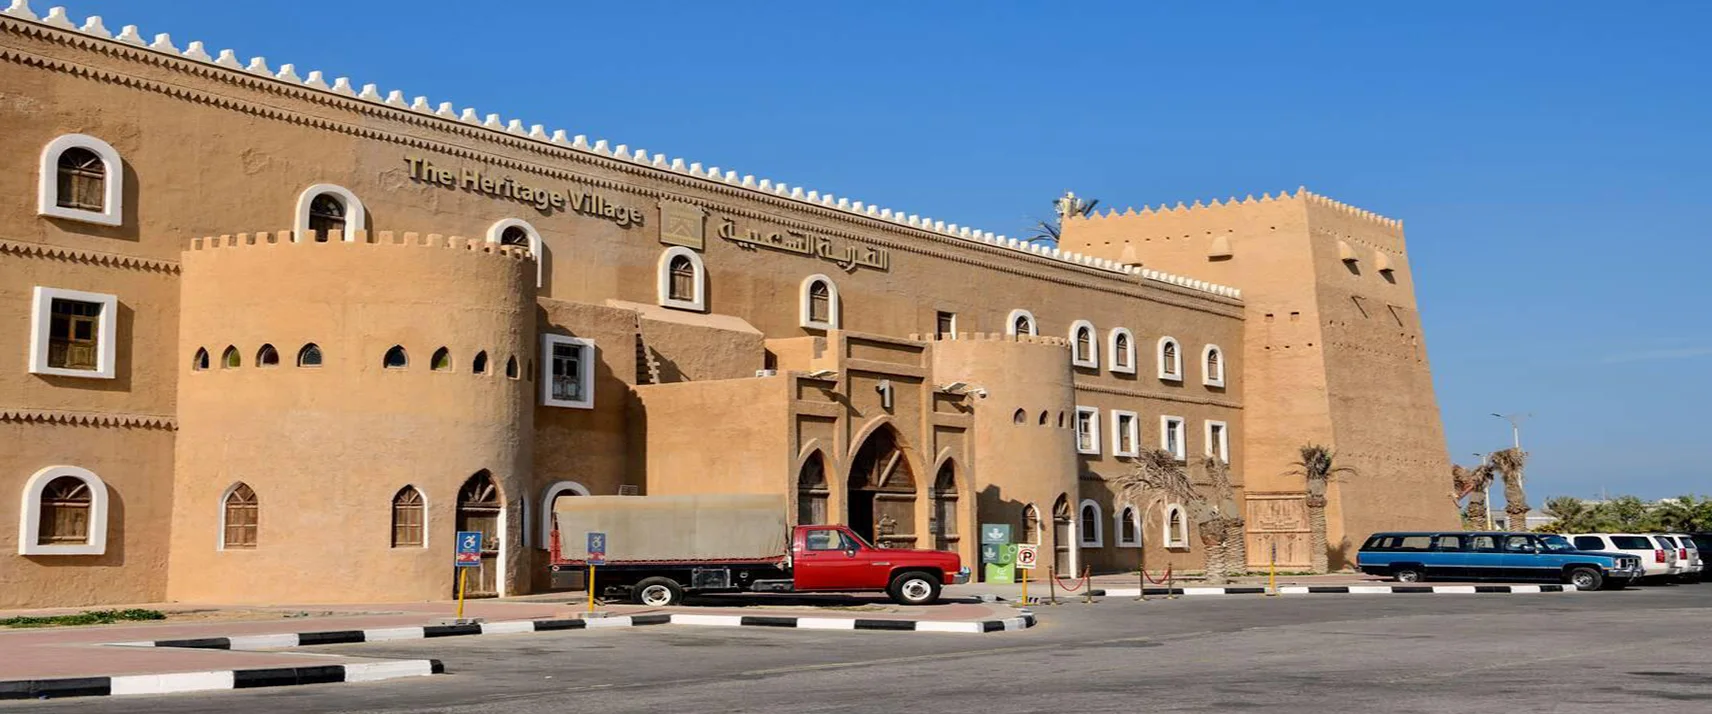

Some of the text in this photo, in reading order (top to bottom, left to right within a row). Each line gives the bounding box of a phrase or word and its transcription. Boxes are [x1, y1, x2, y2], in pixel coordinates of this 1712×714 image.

[405, 156, 643, 225] The Heritage Village
[718, 217, 889, 272] القرية الشعبية
[877, 379, 891, 408] 1
